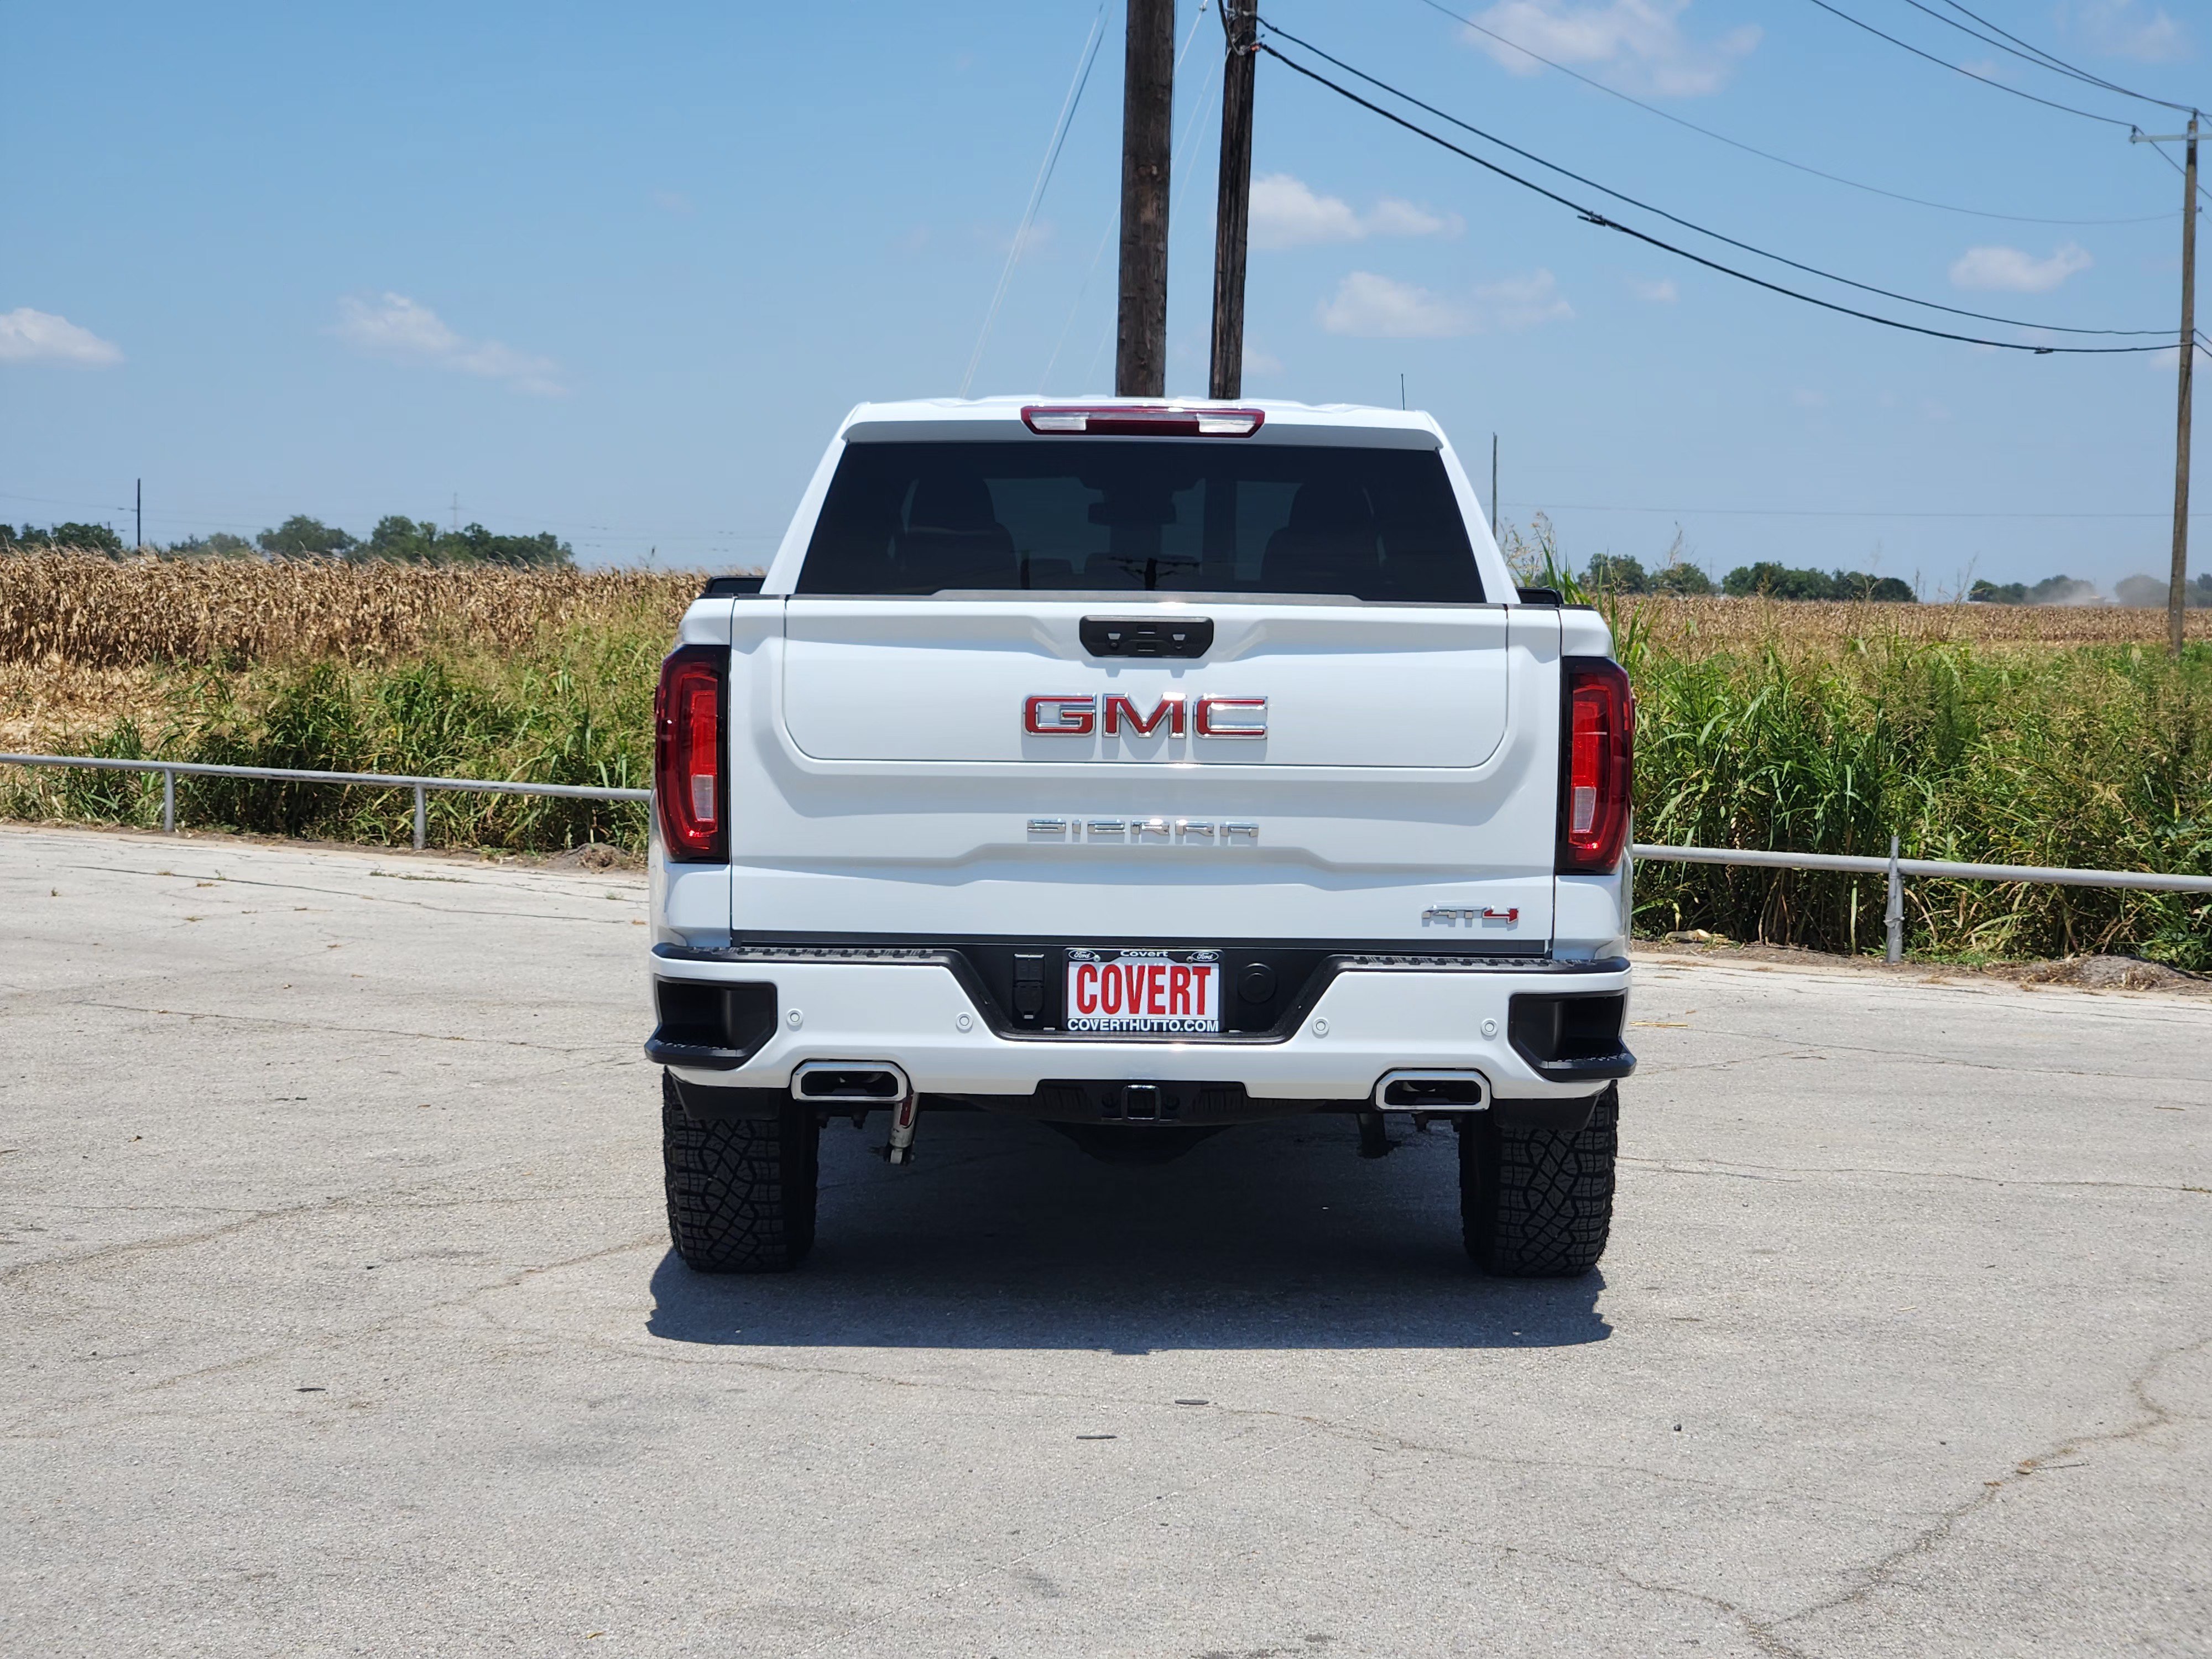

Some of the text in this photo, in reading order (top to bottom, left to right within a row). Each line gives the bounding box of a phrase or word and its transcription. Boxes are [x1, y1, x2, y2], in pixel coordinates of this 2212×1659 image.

[1022, 692, 1268, 739] GMC
[1027, 818, 1259, 837] SIERRA
[1421, 905, 1519, 924] AT4
[1073, 950, 1091, 959] Ford
[1196, 951, 1214, 960] Ford
[1076, 963, 1211, 1015] COVERT
[1067, 1019, 1219, 1032] COVERTHUTTO.COM
